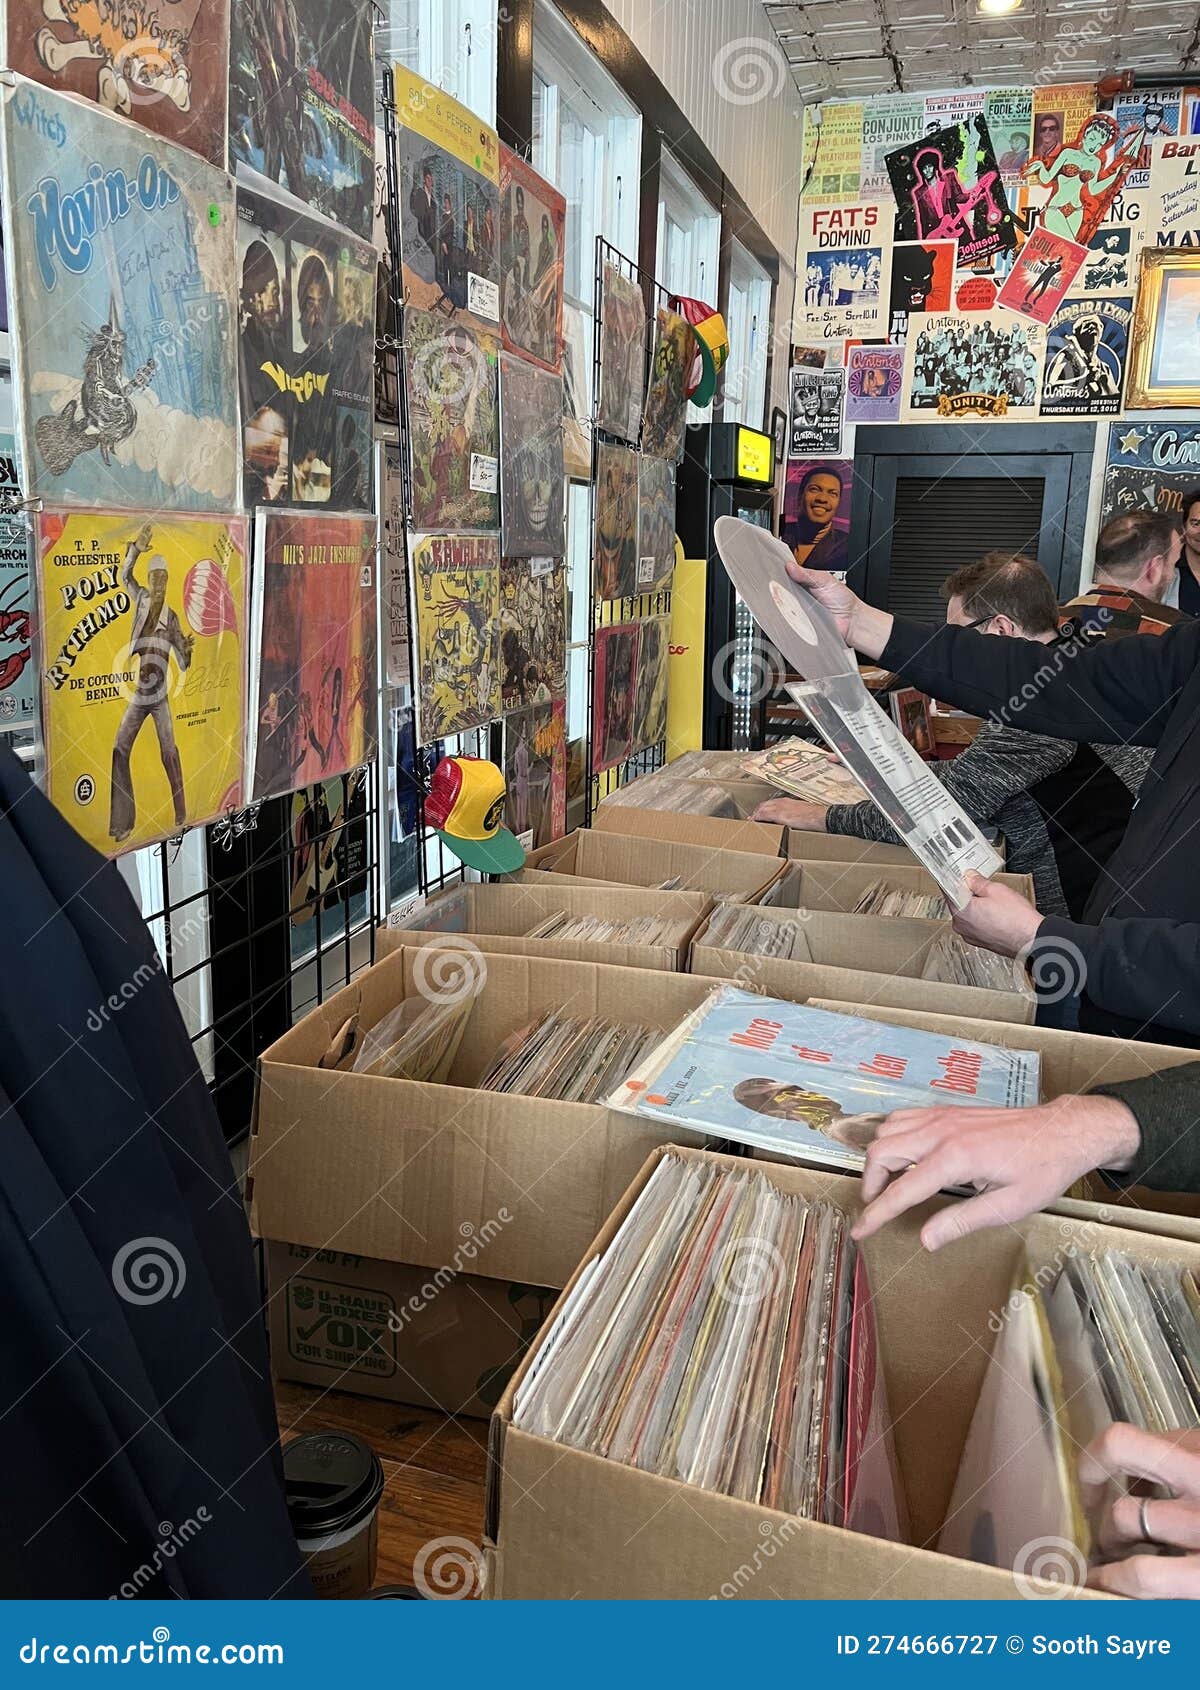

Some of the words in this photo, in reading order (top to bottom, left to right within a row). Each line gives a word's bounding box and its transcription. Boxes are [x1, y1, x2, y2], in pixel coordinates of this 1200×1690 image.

[988, 102, 1014, 115] EDDIE
[1119, 95, 1140, 106] FEB
[1142, 93, 1158, 105] 21
[1162, 92, 1180, 102] FRI
[862, 115, 923, 136] CONJUNTO
[863, 134, 883, 145] LOS
[887, 130, 924, 143] PINKYS
[1160, 180, 1198, 205] Thursday
[812, 206, 879, 236] FATS
[1161, 203, 1198, 228] Saturday
[818, 229, 871, 249] DOMINO
[958, 233, 1000, 258] Johnson
[1029, 236, 1055, 257] SOUL
[260, 361, 330, 403] VIRGIN
[1043, 384, 1090, 401] Antone's
[952, 396, 994, 410] UNITY
[1042, 405, 1075, 414] THURSDAY
[1076, 405, 1088, 414] MAY
[1100, 404, 1118, 413] 2016
[74, 540, 85, 552] T.
[91, 540, 100, 552] P.
[283, 544, 304, 566] NIL'S
[308, 544, 327, 565] JAZZ
[54, 553, 121, 566] ORCHESTRE
[60, 565, 120, 610] POLY
[46, 591, 131, 691] RYTHMO
[667, 644, 689, 656] co
[70, 678, 85, 690] DE
[87, 671, 136, 688] COTONOU
[86, 686, 120, 702] BENIN
[728, 1017, 784, 1053] More
[791, 1044, 833, 1063] of
[857, 1053, 908, 1080] Ken
[929, 1049, 983, 1096] Boothe
[342, 1251, 363, 1270] FT
[318, 1288, 390, 1314] U-HAUL
[318, 1303, 390, 1325] BOXES
[326, 1319, 384, 1356] OK
[295, 1342, 322, 1358] FOR
[325, 1349, 387, 1372] SHIPPING
